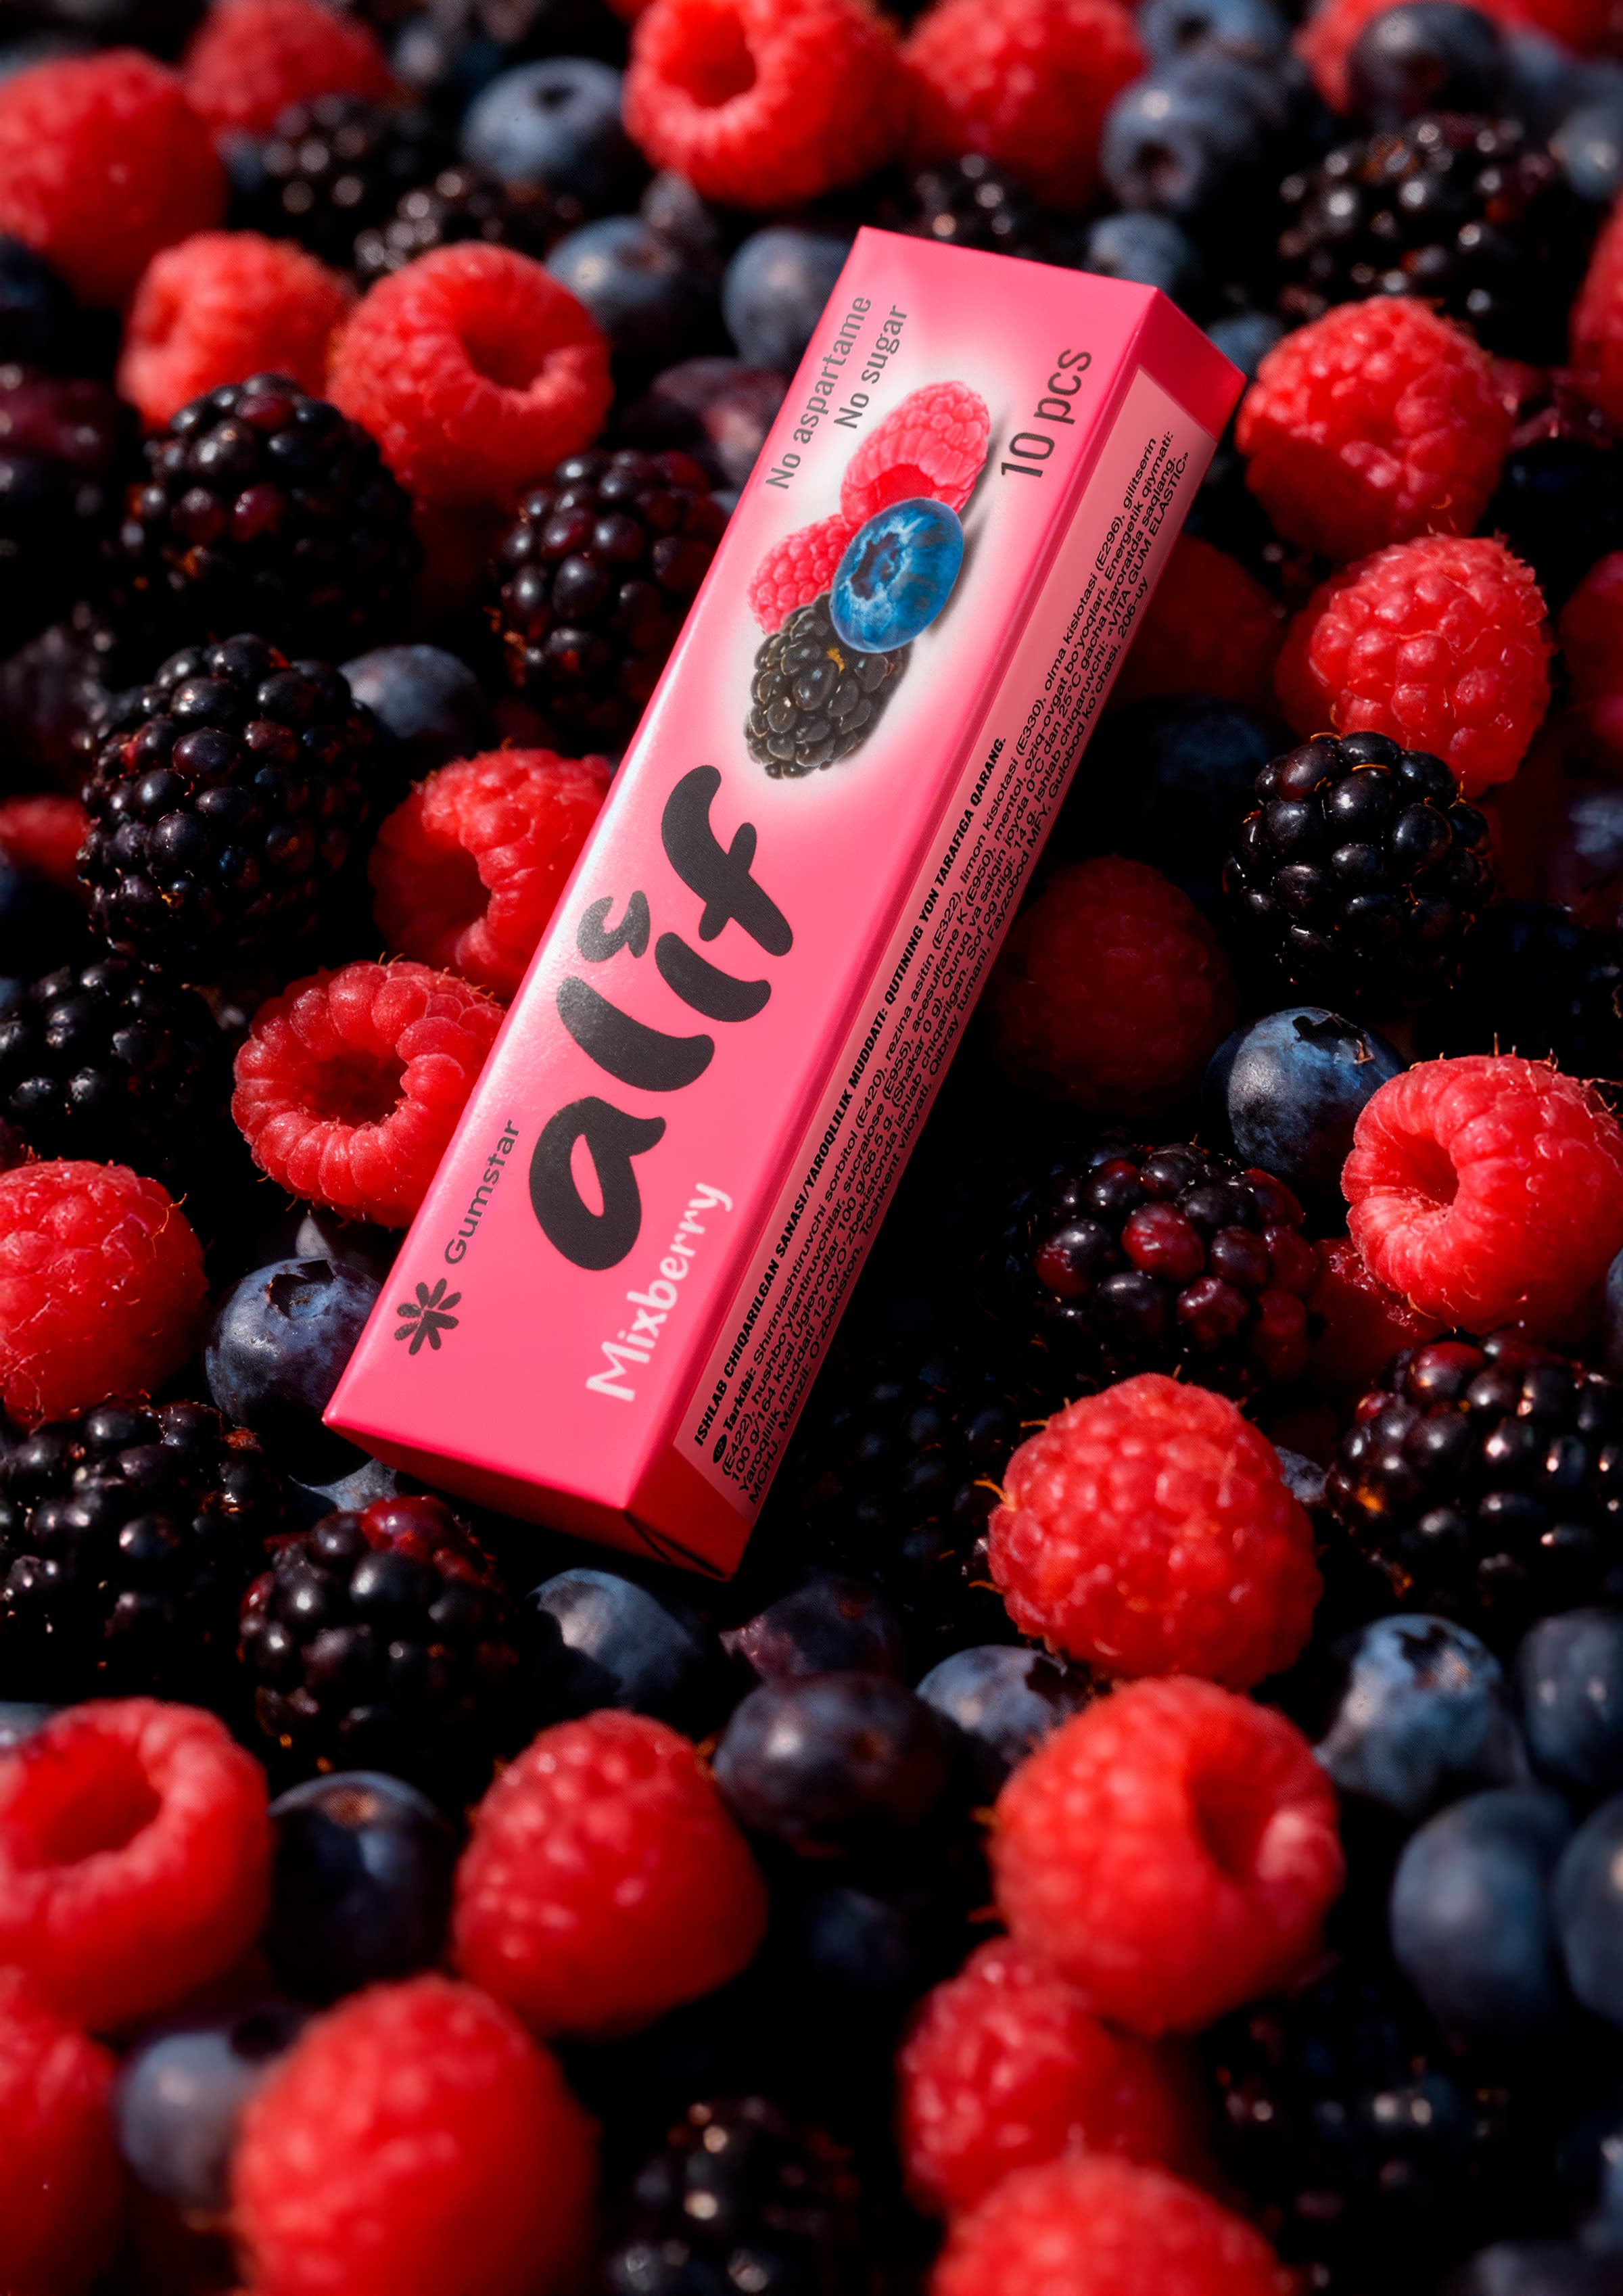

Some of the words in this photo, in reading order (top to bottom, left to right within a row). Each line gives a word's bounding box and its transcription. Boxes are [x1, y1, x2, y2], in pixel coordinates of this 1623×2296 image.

[766, 453, 801, 489] No
[793, 296, 872, 444] aspartame
[834, 393, 870, 429] No
[862, 304, 908, 384] sugar
[1000, 431, 1056, 478] 10
[1033, 348, 1092, 425] pcs
[444, 1119, 520, 1265] Gumstar
[528, 764, 794, 1271] alif
[693, 1378, 728, 1447] ISHLAB
[723, 1257, 780, 1378] CHIQARILGAN
[774, 1087, 853, 1259] SANASI/YAROQLILIK
[847, 1007, 888, 1090] MUDDATI:
[883, 924, 924, 1006] QUTINING
[918, 887, 939, 922] YON
[933, 808, 974, 887] TARAFIGA
[969, 737, 1006, 807] QARANG.
[721, 1411, 755, 1476] (E422),
[843, 1102, 885, 1193] sucralose
[881, 1038, 914, 1100] (E955),
[912, 928, 960, 1033] acesulfame
[956, 907, 968, 926] K
[964, 847, 997, 907] (E950),
[993, 776, 1027, 842] mentol,
[1103, 500, 1144, 582] Energetik
[1141, 430, 1173, 498] qiymati:
[722, 1366, 757, 1432] Tarkibi:
[753, 1202, 826, 1365] Shirinlashtiruvchi
[824, 1129, 858, 1203] sorbitol
[854, 1067, 888, 1129] (E420),
[885, 1005, 913, 1061] rezina
[910, 952, 935, 1003] asitin
[931, 889, 964, 950] (E322),
[959, 833, 986, 885] limon
[981, 756, 1018, 831] kislotasi
[1015, 697, 1047, 756] (E330),
[1043, 647, 1066, 691] olma
[1062, 571, 1098, 645] kislotasi
[1094, 515, 1125, 571] (E296),
[1123, 438, 1156, 510] gilitserin
[730, 1445, 751, 1482] 100
[749, 1386, 776, 1445] g/164
[837, 1196, 857, 1231] 100
[855, 1131, 884, 1196] g/66.5
[882, 1113, 894, 1132] g.
[891, 1035, 924, 1108] (Shakar
[922, 1018, 932, 1034] 0
[931, 995, 945, 1018] g).
[941, 931, 972, 989] Quruq
[968, 905, 983, 927] va
[979, 848, 1006, 903] salqin
[1002, 795, 1029, 849] joyda
[1043, 720, 1062, 755] dan
[1080, 615, 1107, 672] gacha
[1102, 529, 1144, 613] haroratda
[1141, 456, 1176, 527] saqlang.
[738, 1407, 781, 1491] Yaroqlilik
[778, 1318, 816, 1405] muddati
[813, 1294, 828, 1318] 12
[893, 1072, 922, 1129] ishlab
[920, 966, 969, 1069] chiqarilgan.
[966, 924, 984, 961] Sof
[1013, 826, 1027, 849] 14
[1025, 809, 1037, 826] g.
[1033, 749, 1061, 803] Ishlab
[1059, 640, 1108, 747] chiqaruvchi:
[1127, 537, 1152, 585] GUM
[747, 1438, 782, 1505] MCHJ.
[777, 1362, 812, 1433] Manzil:
[858, 1152, 900, 1236] Toshkent
[897, 1082, 932, 1149] viloyati,
[928, 1014, 959, 1076] Qibray
[956, 947, 991, 1012] tumani,
[985, 849, 1030, 941] Fayzobod
[1025, 802, 1052, 849] MFY,
[1048, 720, 1085, 799] Gulobod
[1116, 576, 1148, 639] 206-uy
[584, 1182, 733, 1402] Mixberry
